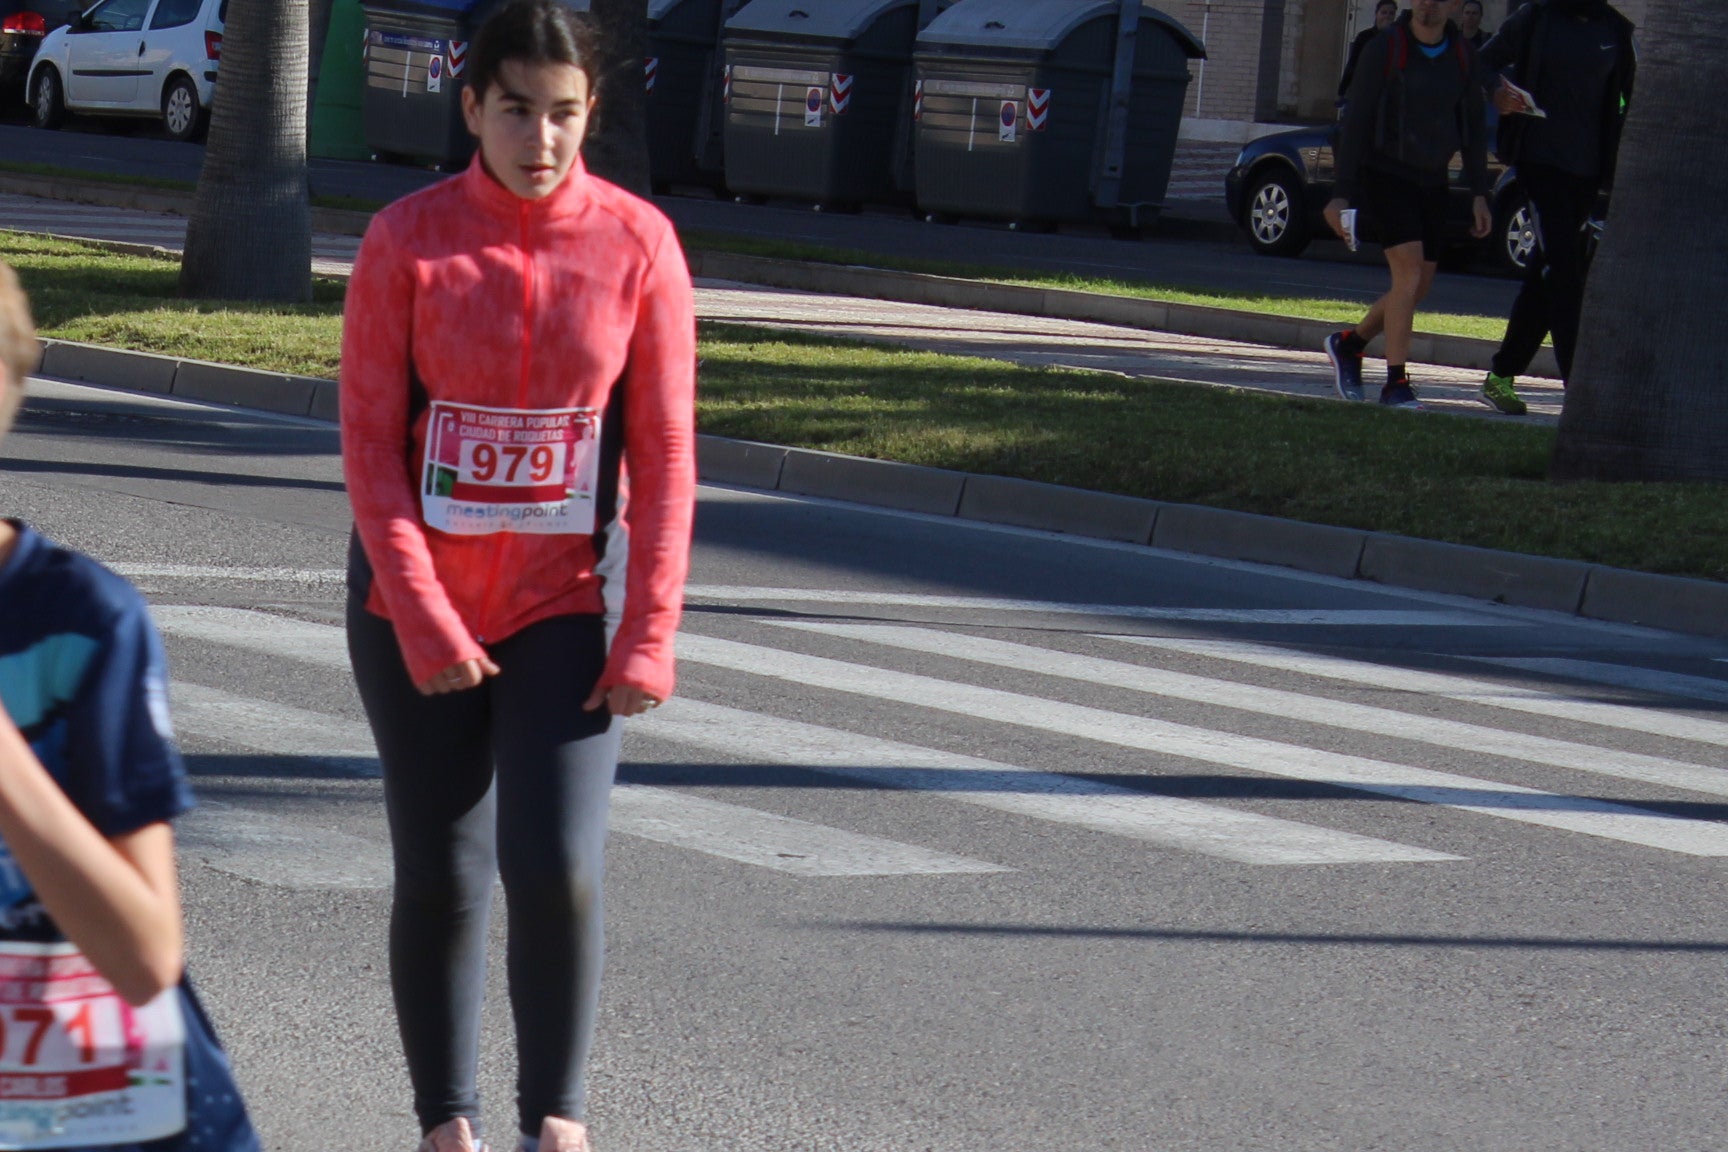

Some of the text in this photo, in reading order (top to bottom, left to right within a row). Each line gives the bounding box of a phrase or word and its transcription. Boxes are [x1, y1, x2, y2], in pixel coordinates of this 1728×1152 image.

[478, 413, 524, 428] CARRERA
[525, 415, 571, 428] POPULAR
[458, 424, 564, 442] CIUDAD DE ROQUETAS
[471, 442, 554, 482] 979
